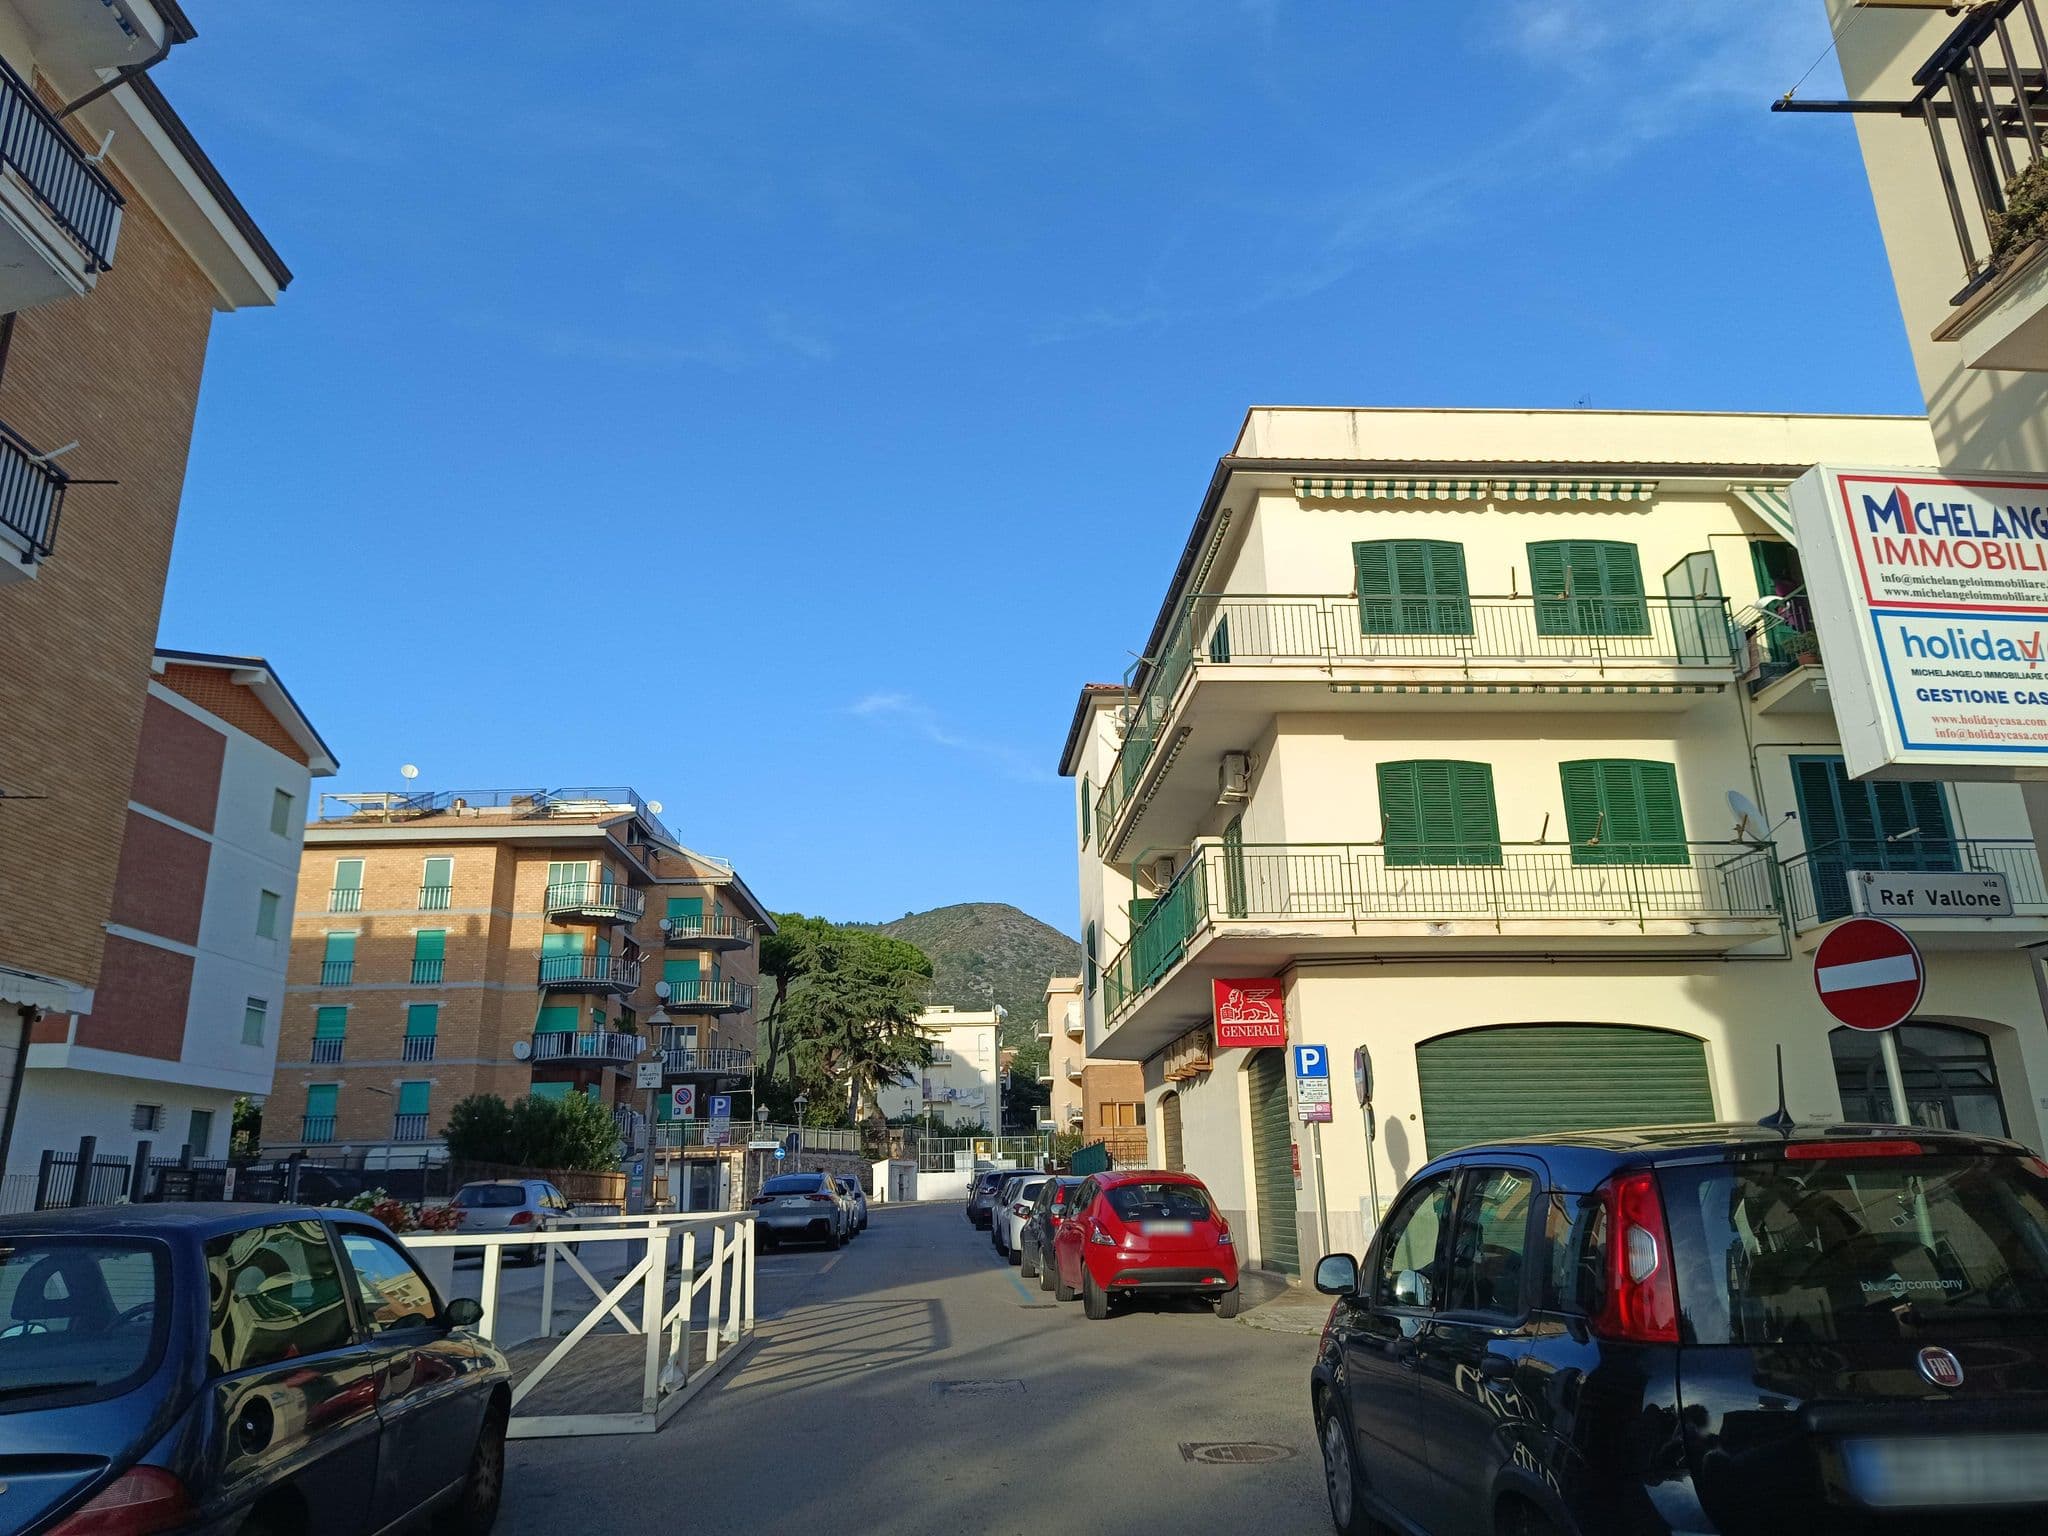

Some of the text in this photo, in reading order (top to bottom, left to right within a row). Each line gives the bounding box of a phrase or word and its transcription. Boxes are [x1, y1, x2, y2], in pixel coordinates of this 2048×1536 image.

[1862, 485, 2048, 540] MICHELANG
[1873, 536, 2048, 571] IMMOBILI
[1881, 573, 2048, 589] info@michelangeloimmobiliare.
[1900, 626, 2042, 669] holiday
[1911, 668, 1982, 679] MICHELANGELO
[1984, 671, 2044, 680] IMMOBILIARE
[1916, 688, 2048, 705] GESTIONE CAS
[1931, 715, 2047, 727] www.holidaycasa.com
[1982, 879, 1998, 888] via
[1880, 889, 2001, 907] Raf Vallone
[1221, 1024, 1281, 1038] GENERALI
[1300, 1048, 1320, 1075] P
[713, 1098, 726, 1115] P
[1927, 1357, 1956, 1377] FIAT
